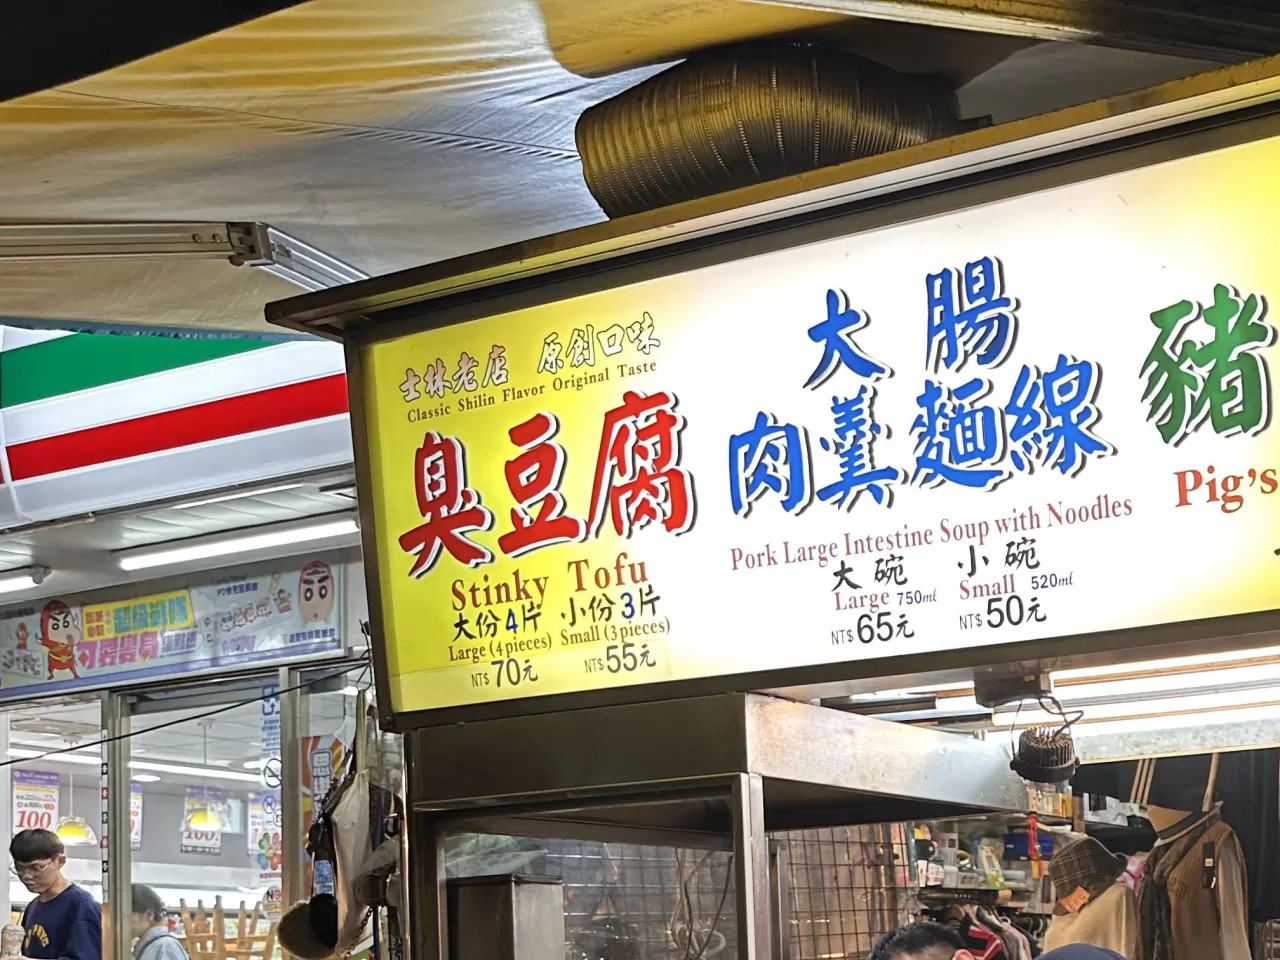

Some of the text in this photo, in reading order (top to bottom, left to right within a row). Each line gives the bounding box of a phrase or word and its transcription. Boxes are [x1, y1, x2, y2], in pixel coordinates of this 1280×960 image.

[398, 312, 661, 403] 士林老店 原創口味
[407, 360, 657, 424] Classic Shilin Flavor Original Taste
[728, 354, 1118, 518] 肉羹麵線
[398, 391, 697, 578] 臭豆腐
[730, 494, 1133, 571] Pork Large Intestine Soup with Noodles
[451, 552, 649, 612] Stinky Tofu
[831, 536, 1041, 592] 大碗 小碗
[834, 589, 890, 613] Large
[959, 574, 1016, 600] Small
[452, 584, 661, 642] 大份4片 小份3片
[448, 644, 487, 665] Large
[560, 626, 600, 647] Small
[15, 810, 52, 829] 100
